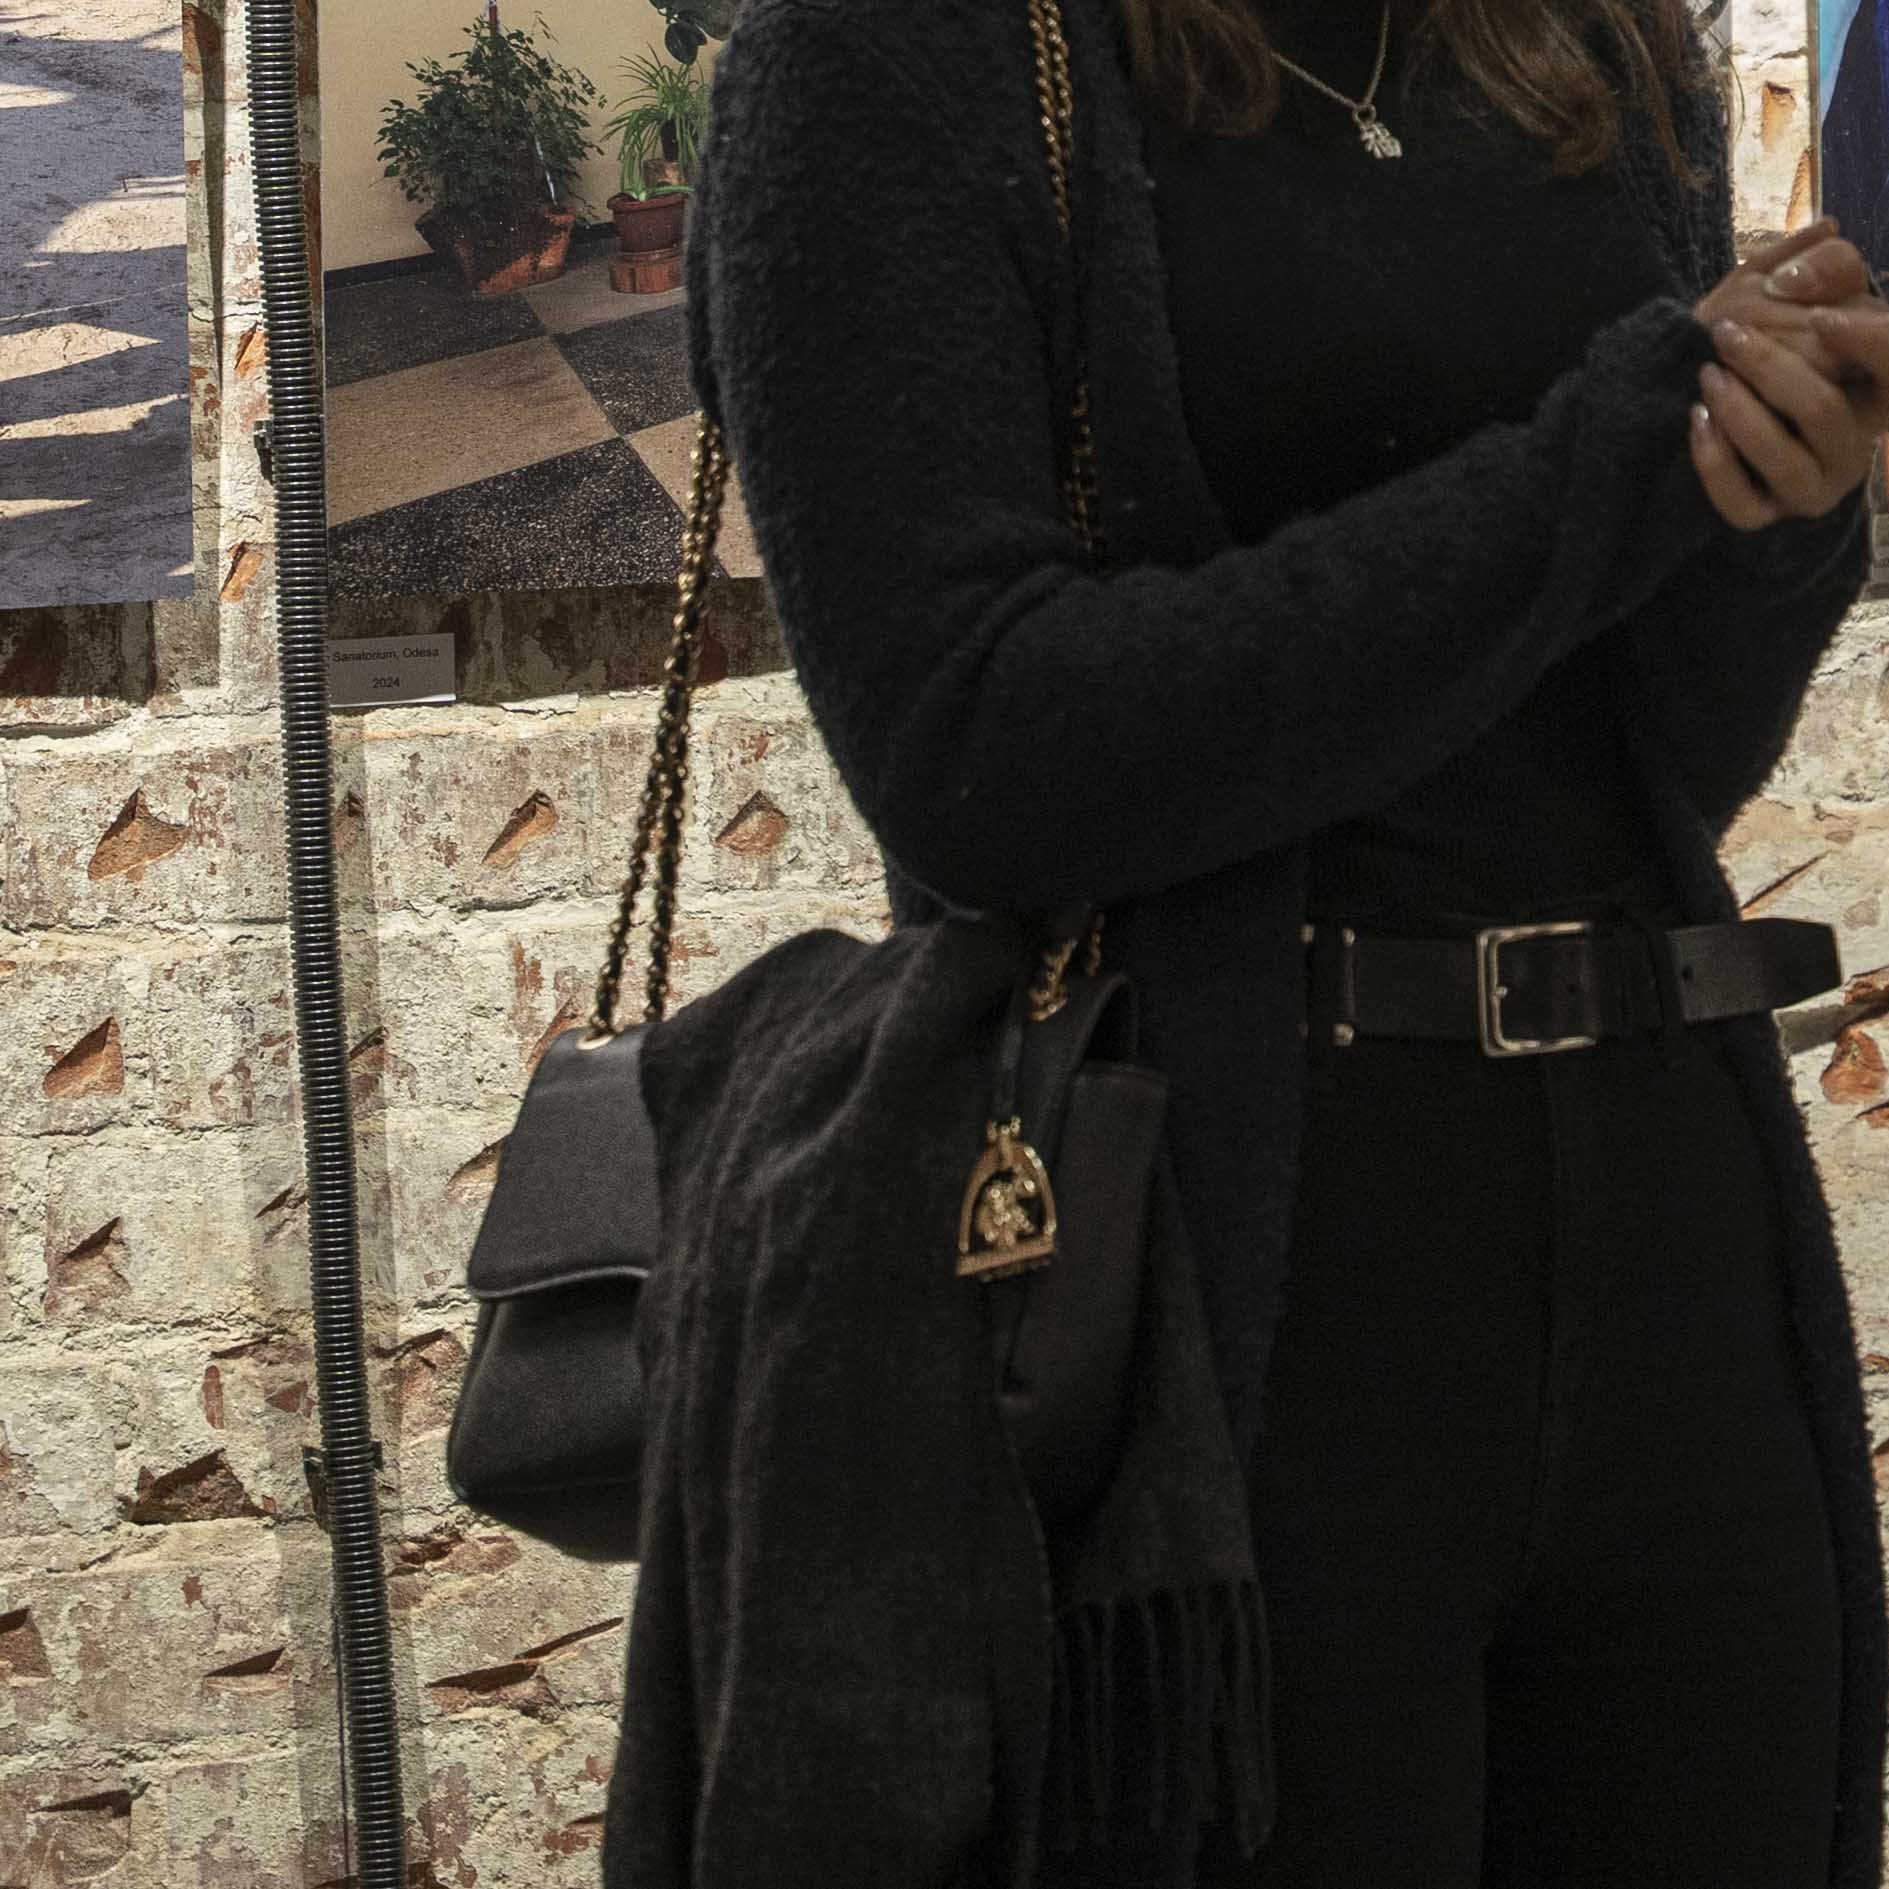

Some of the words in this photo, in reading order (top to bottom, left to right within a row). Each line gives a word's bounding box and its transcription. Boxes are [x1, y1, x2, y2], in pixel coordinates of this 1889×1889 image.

[332, 649, 399, 663] Sanatorium,
[402, 646, 440, 659] Odesa
[372, 677, 400, 689] 2024
